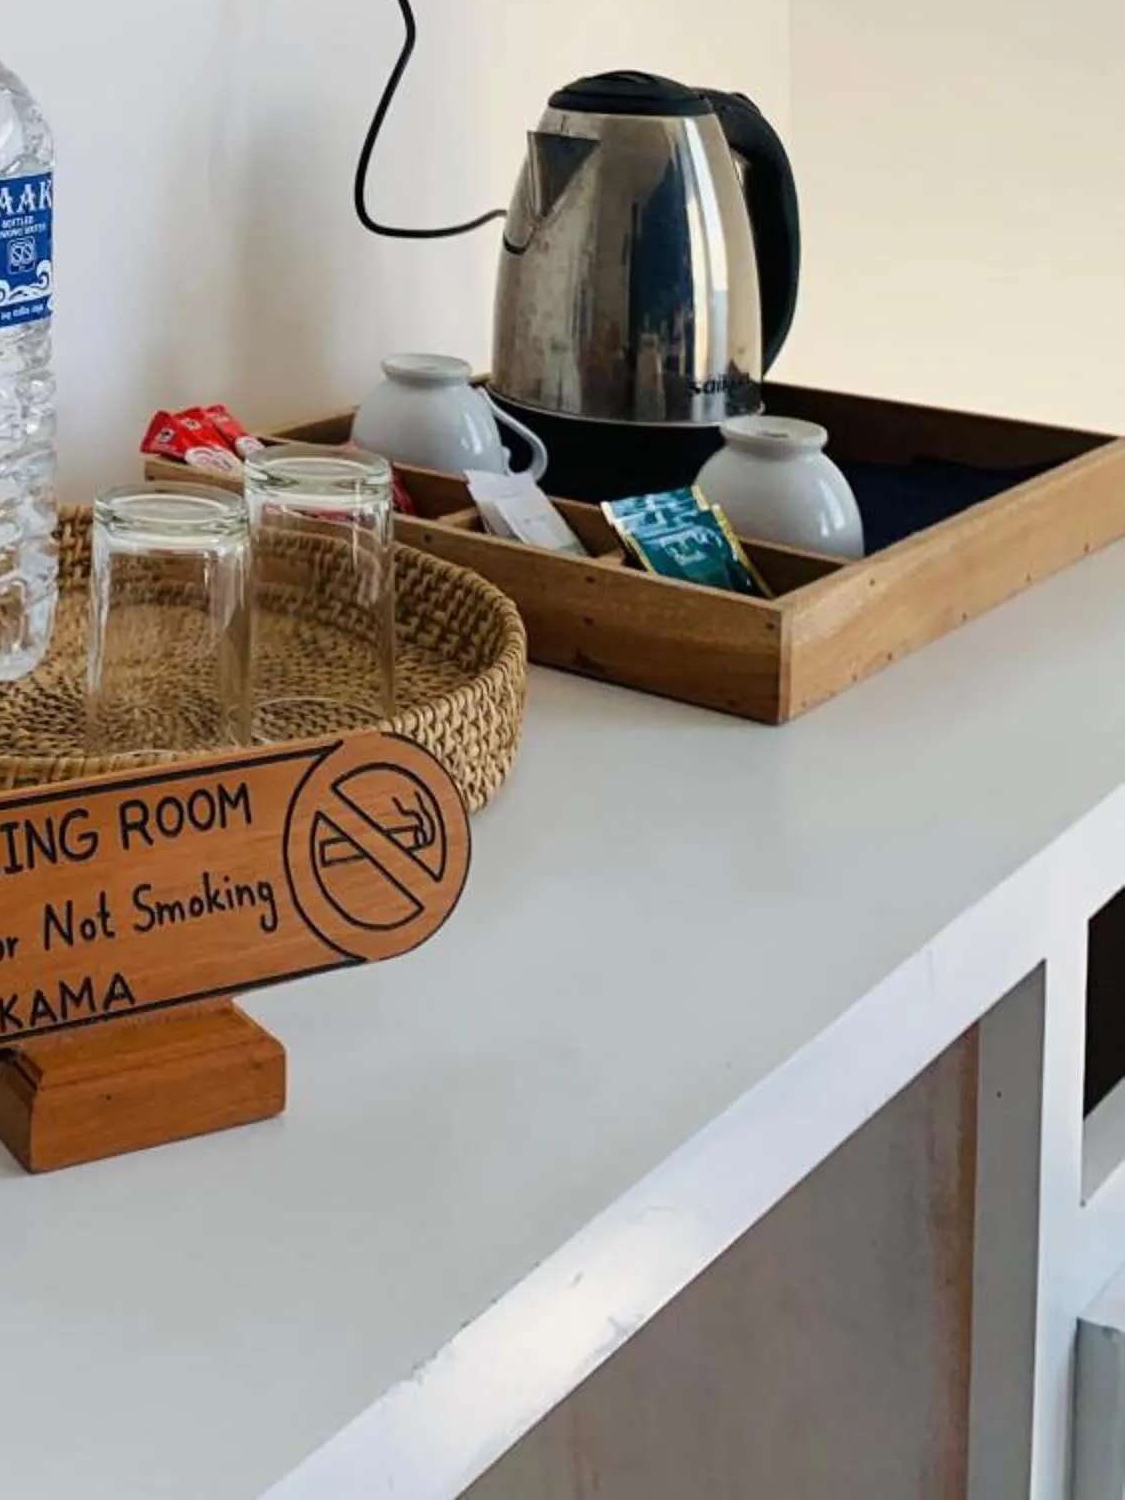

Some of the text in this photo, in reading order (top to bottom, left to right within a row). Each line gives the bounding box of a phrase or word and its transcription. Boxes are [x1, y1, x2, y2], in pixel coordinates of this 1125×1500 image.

[118, 782, 252, 851] ROOM
[43, 892, 115, 951] Not
[131, 872, 279, 934] Smoking
